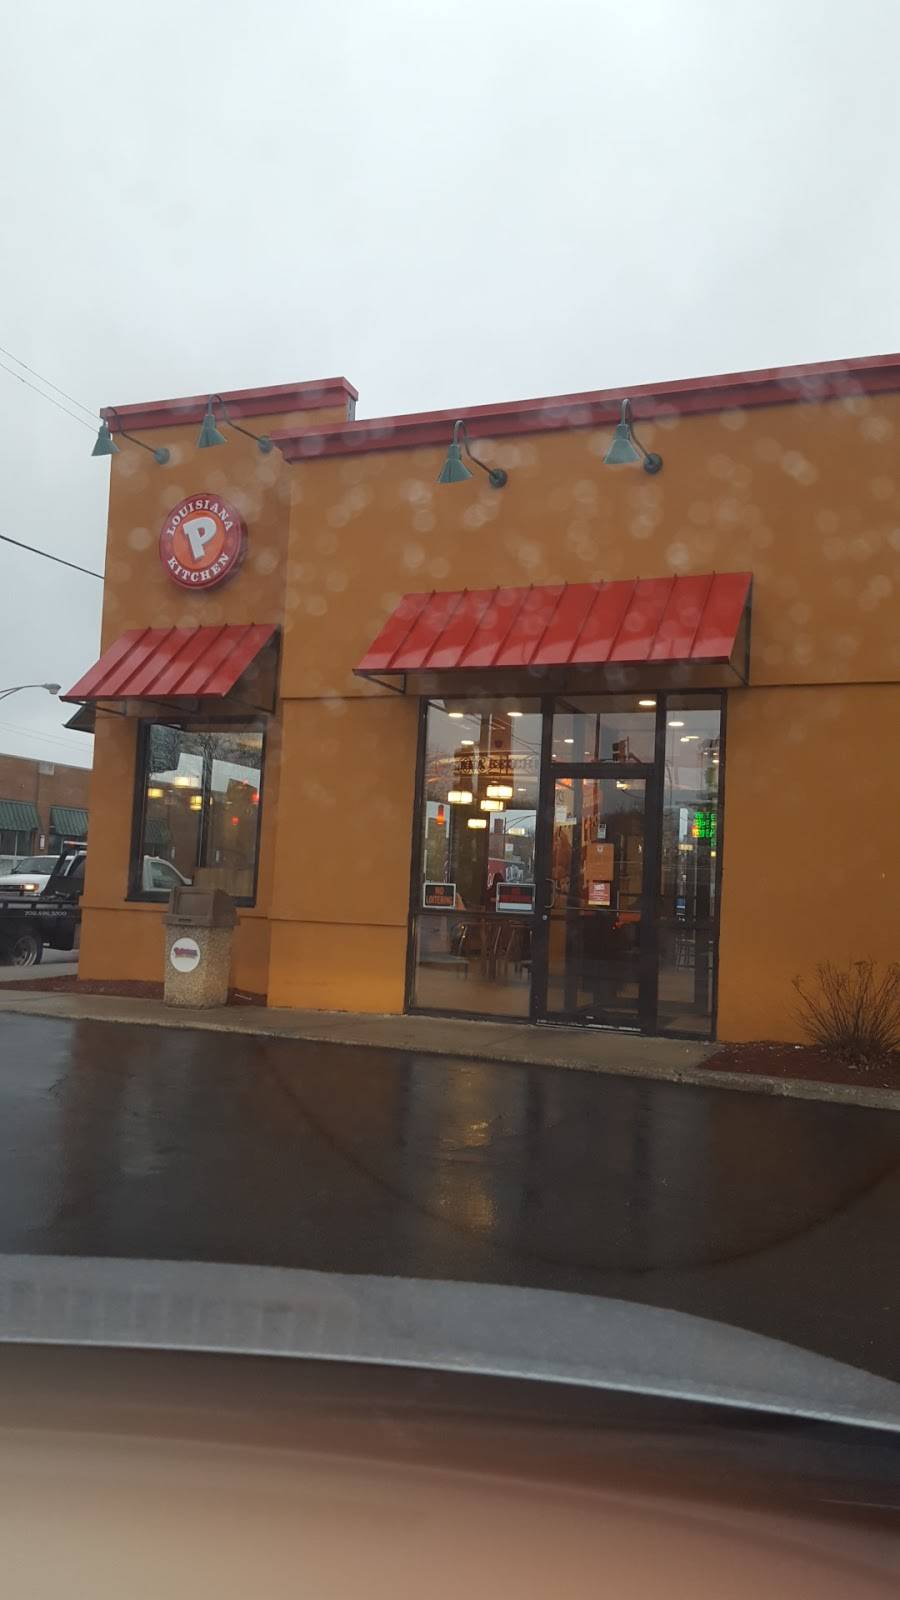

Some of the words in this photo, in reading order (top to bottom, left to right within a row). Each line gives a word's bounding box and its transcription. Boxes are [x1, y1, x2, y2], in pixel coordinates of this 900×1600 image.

[167, 500, 233, 536] LOUISIANA
[183, 516, 216, 560] P
[167, 553, 229, 581] KITCHEN
